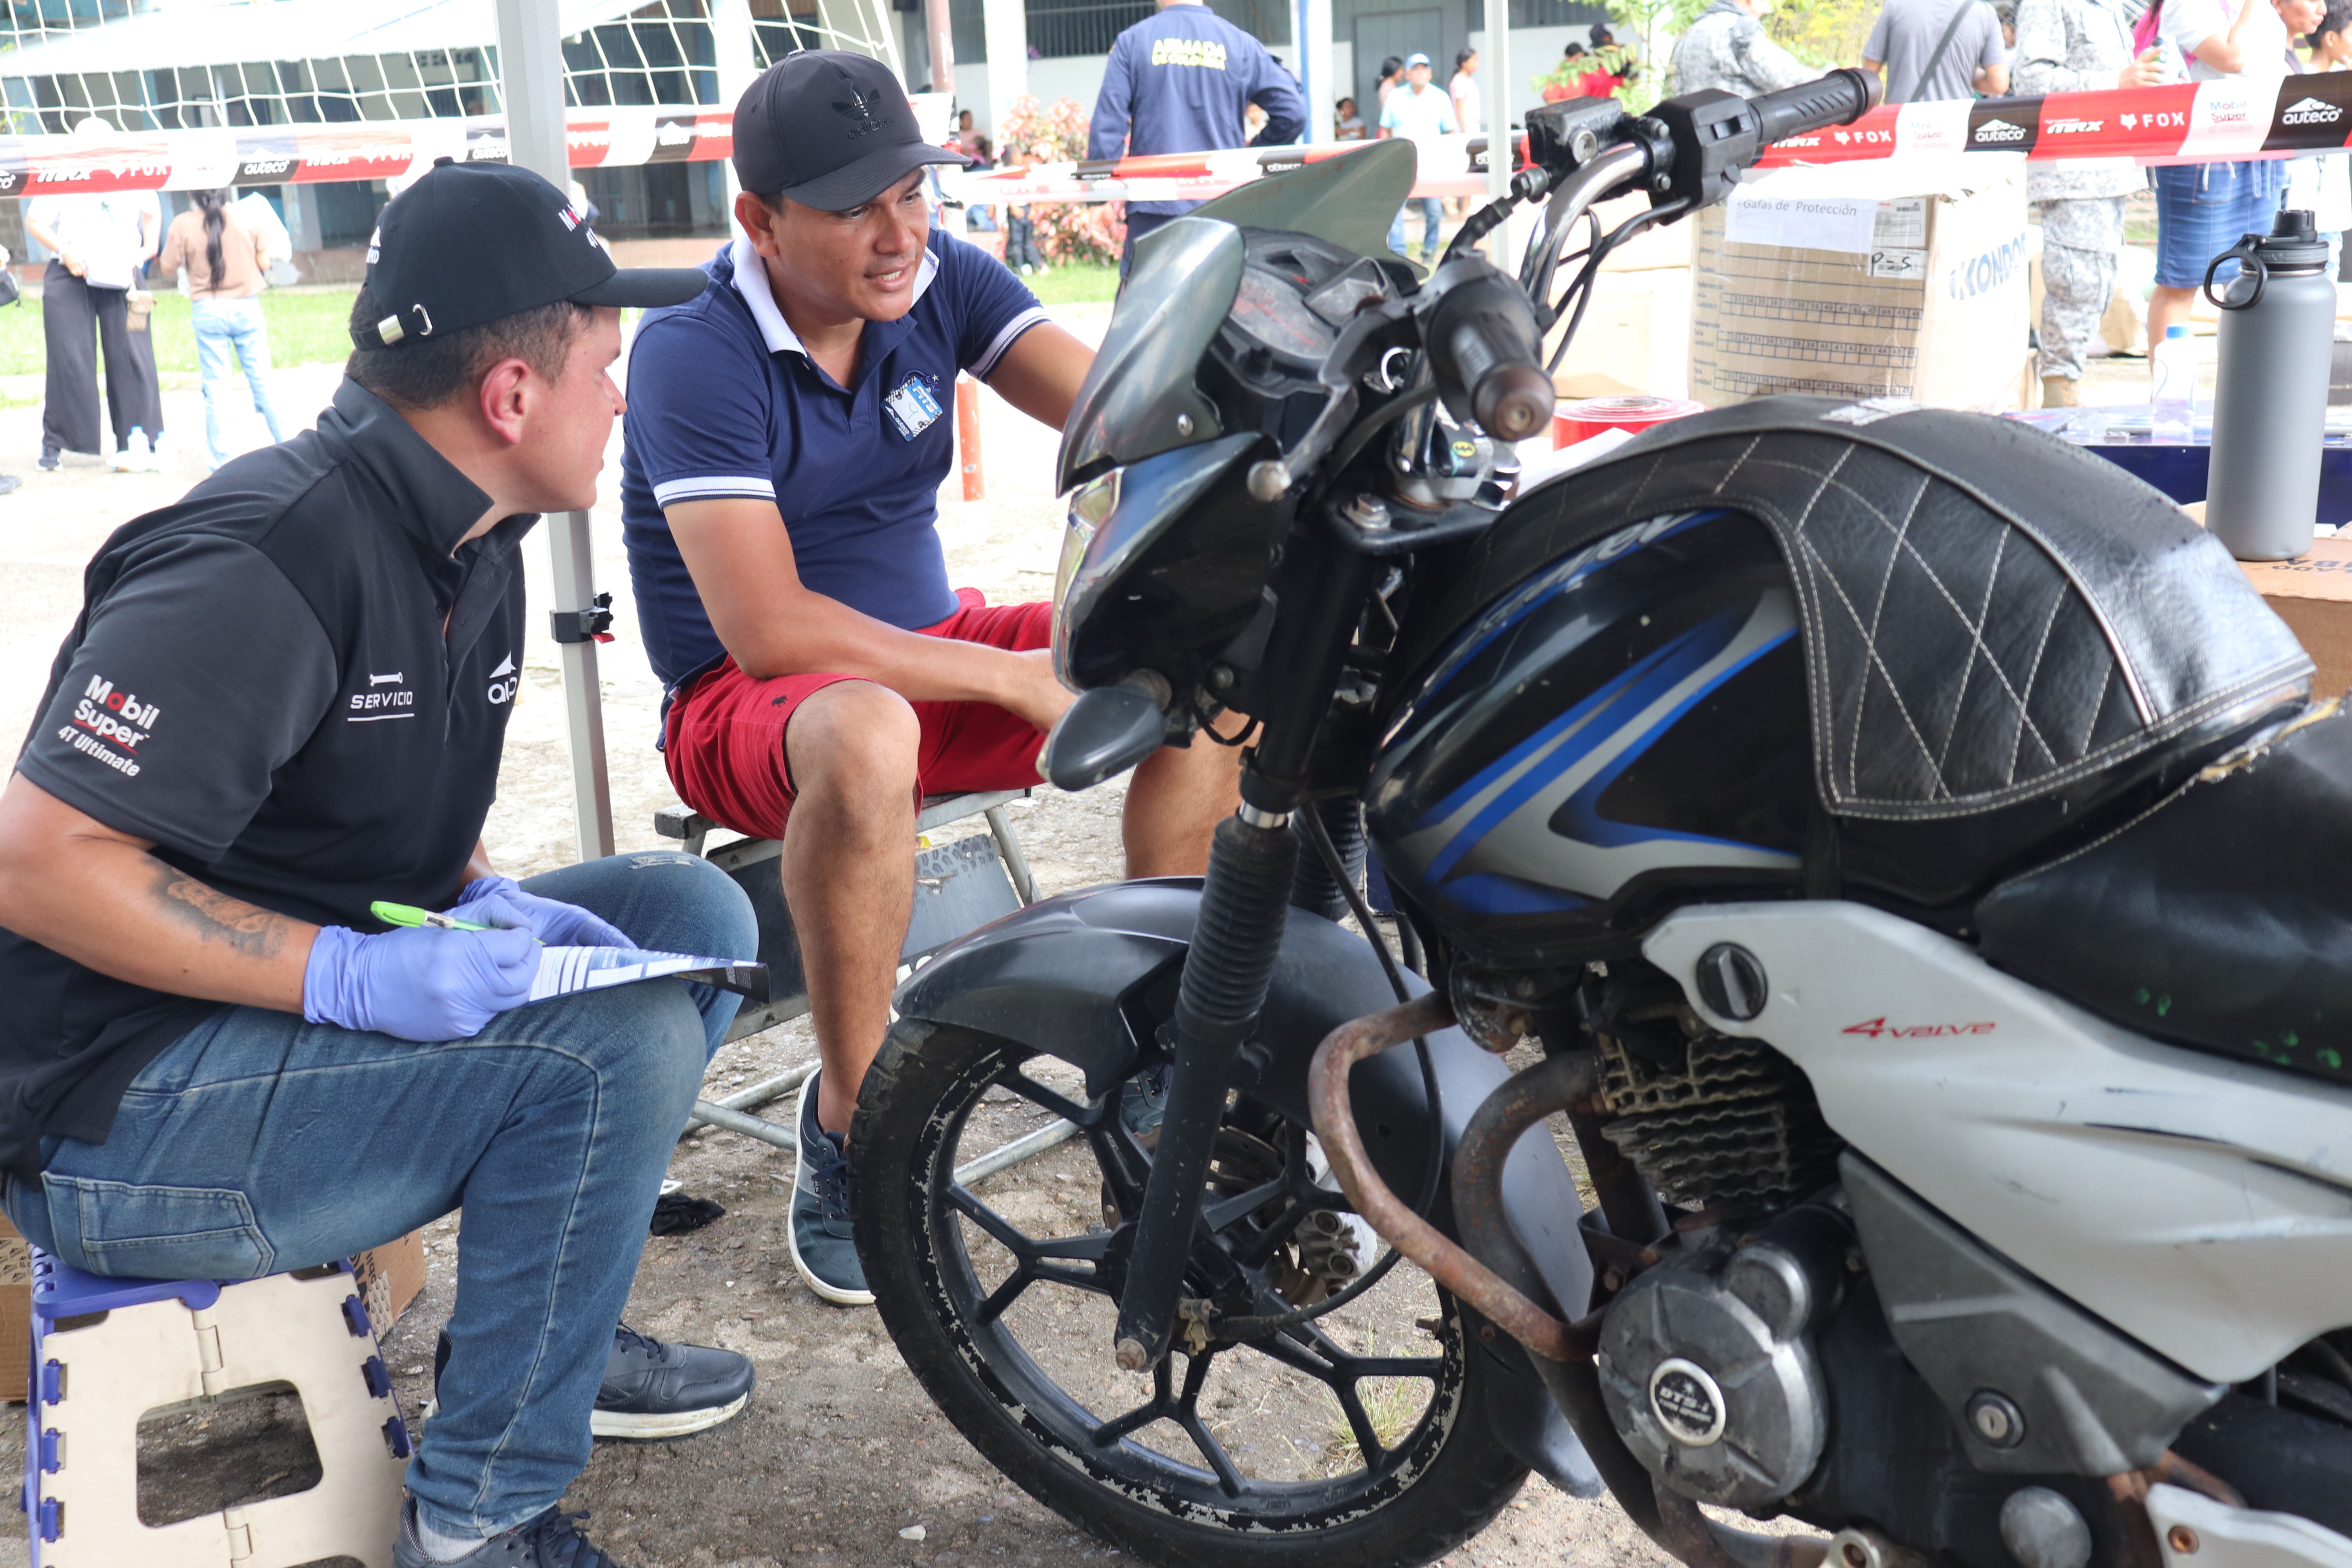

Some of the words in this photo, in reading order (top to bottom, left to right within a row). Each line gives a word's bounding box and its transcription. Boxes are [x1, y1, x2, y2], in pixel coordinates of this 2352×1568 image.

[1152, 38, 1227, 60] ARMADA
[2210, 100, 2246, 110] Mobil
[2142, 112, 2185, 127] FOX
[2211, 112, 2246, 121] Super
[2282, 110, 2339, 125] auteco
[1853, 131, 1893, 143] FOX
[1975, 130, 2024, 143] auteco
[244, 161, 287, 175] auteco
[1744, 200, 1772, 209] Gafas
[1776, 201, 1789, 211] de
[1797, 201, 1857, 215] Protección
[895, 417, 909, 434] auteco
[85, 674, 161, 730] Mobil
[350, 691, 413, 710] SERVICIO
[74, 699, 144, 748] Super
[58, 725, 79, 742] 4T
[74, 733, 141, 777] Ultimate
